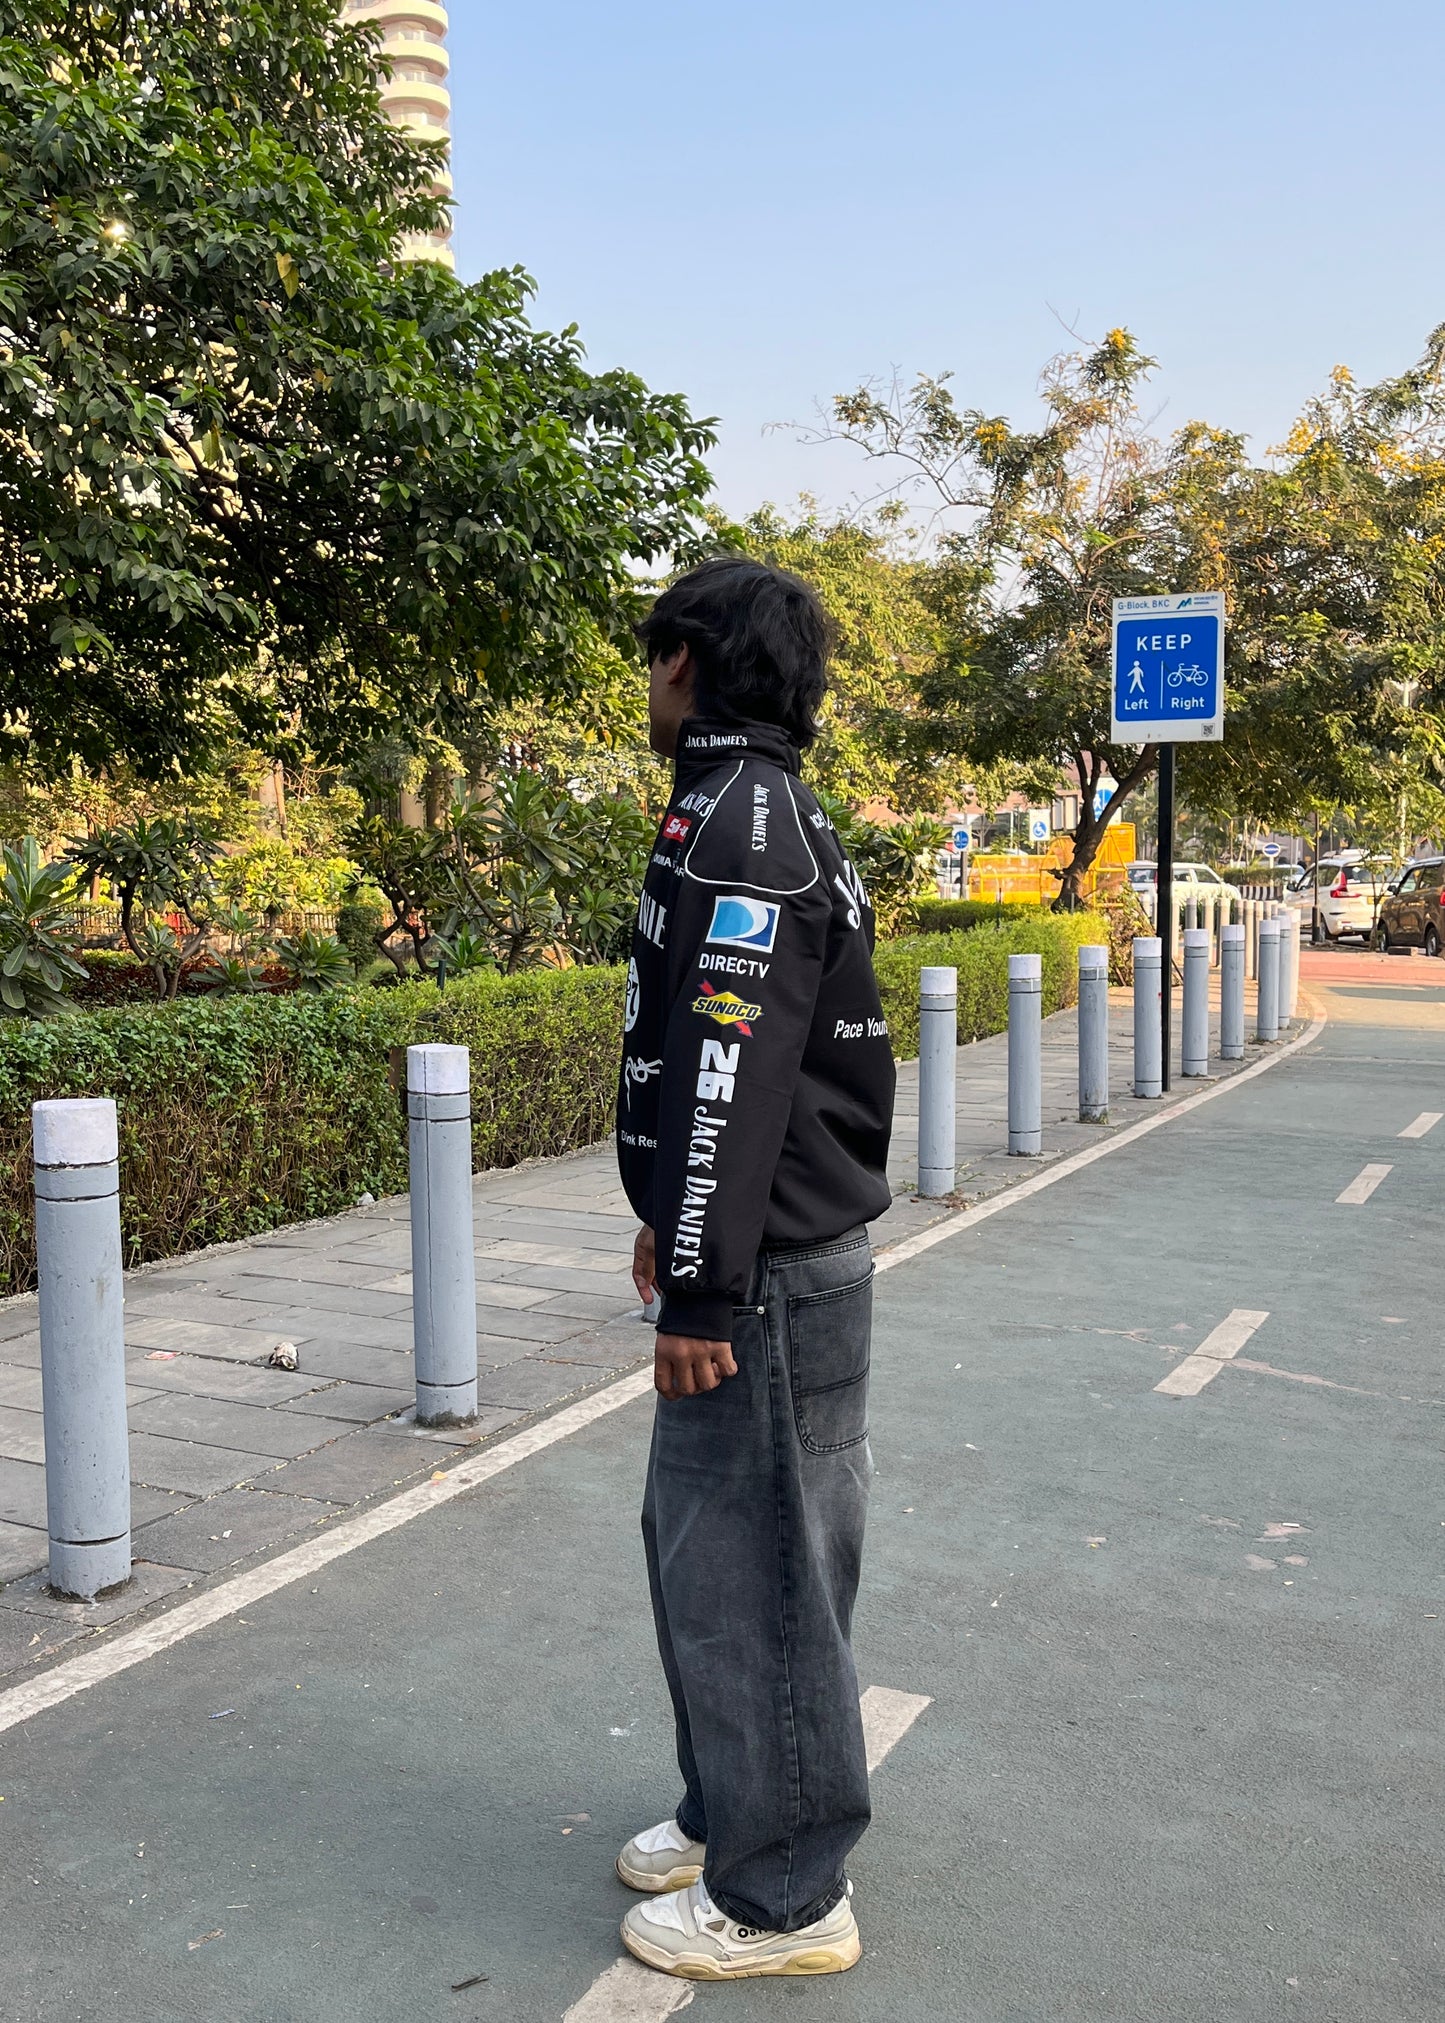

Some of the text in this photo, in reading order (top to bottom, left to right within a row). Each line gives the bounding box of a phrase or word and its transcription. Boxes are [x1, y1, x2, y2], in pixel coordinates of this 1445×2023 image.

[1152, 599, 1170, 608] BKC
[1136, 634, 1192, 651] KEEP
[1124, 697, 1205, 710] Left Right
[685, 734, 748, 748] JACK DANIEL'S
[751, 783, 770, 852] JACK DANIEL'S
[698, 953, 770, 979] DIRECTV
[694, 998, 760, 1019] SUNOCO
[833, 1019, 864, 1039] Pace
[696, 1038, 741, 1103] 26
[670, 1105, 728, 1279] JACK DANIEL'S
